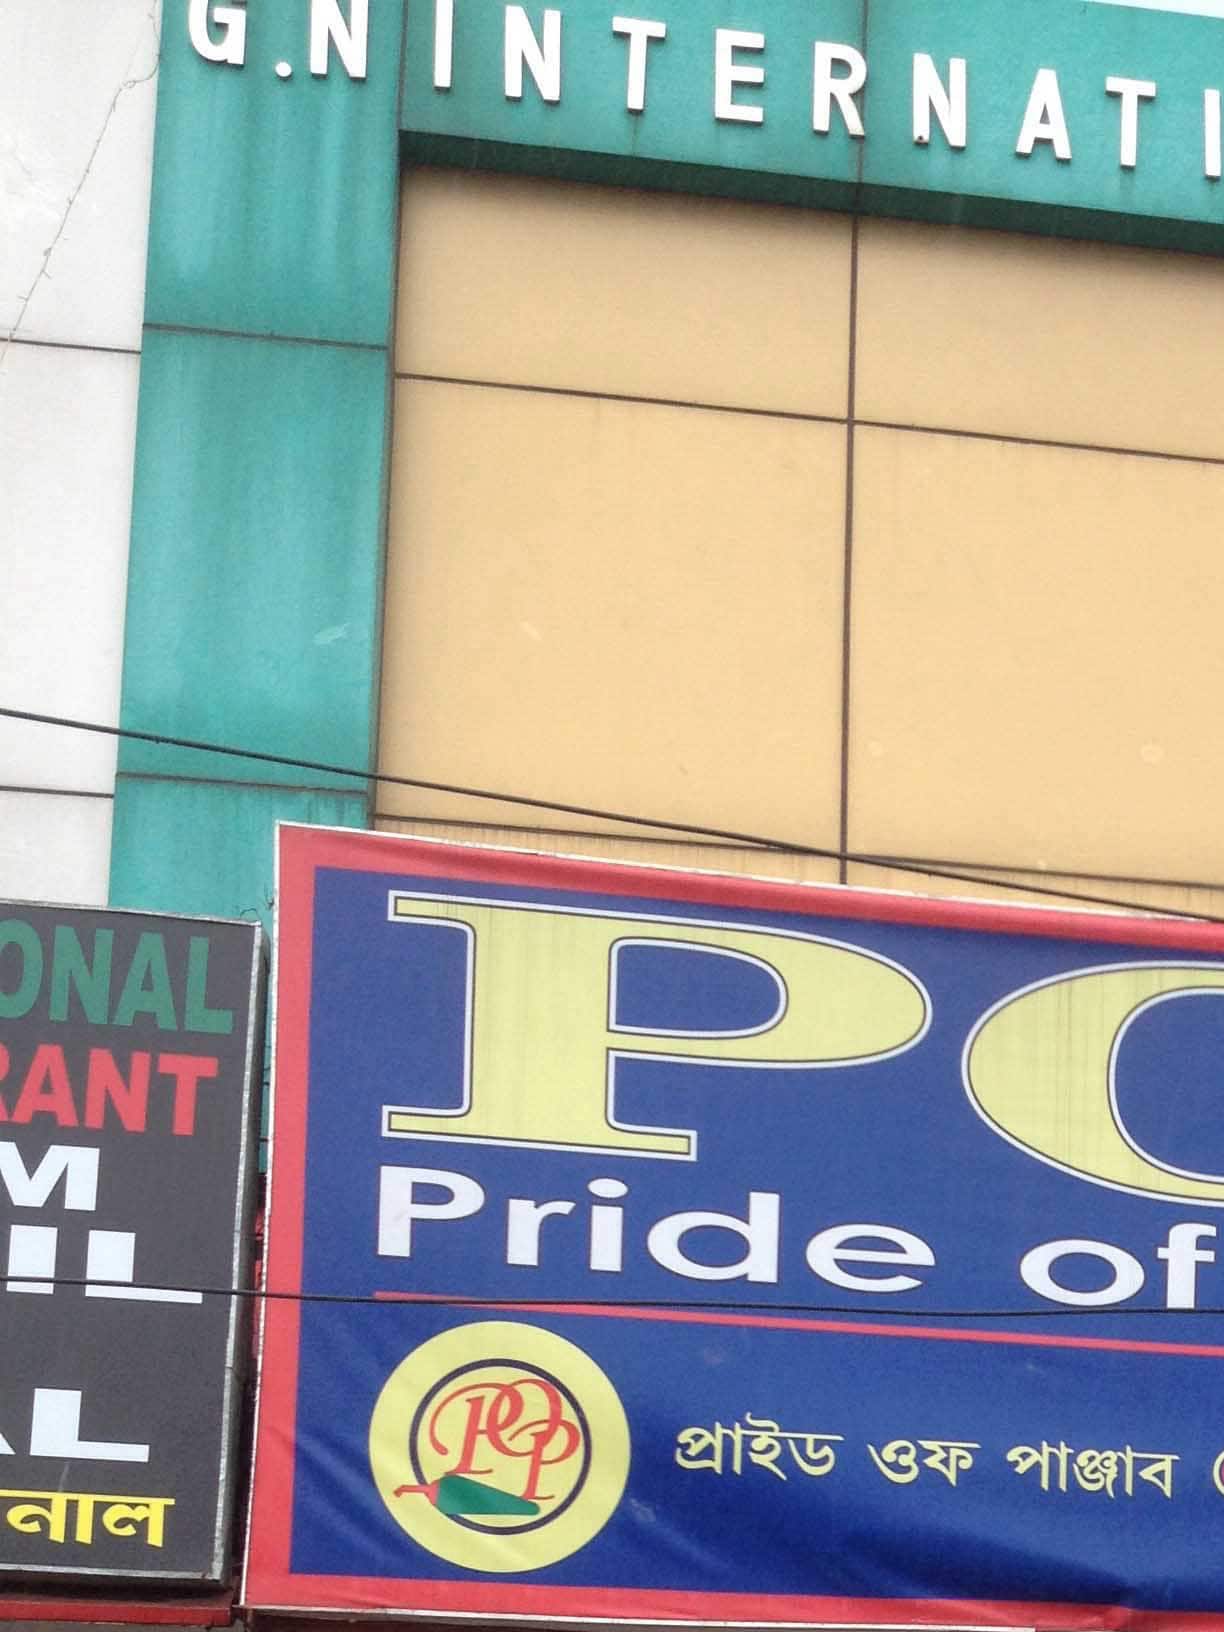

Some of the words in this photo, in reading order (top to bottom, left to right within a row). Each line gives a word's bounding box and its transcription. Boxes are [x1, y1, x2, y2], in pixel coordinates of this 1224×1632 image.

[376, 1164, 936, 1293] Pride
[1018, 1221, 1217, 1309] of
[675, 1412, 845, 1481] প্রাইড
[867, 1439, 982, 1488] ওফ
[1006, 1440, 1181, 1499] পাঞ্জাব
